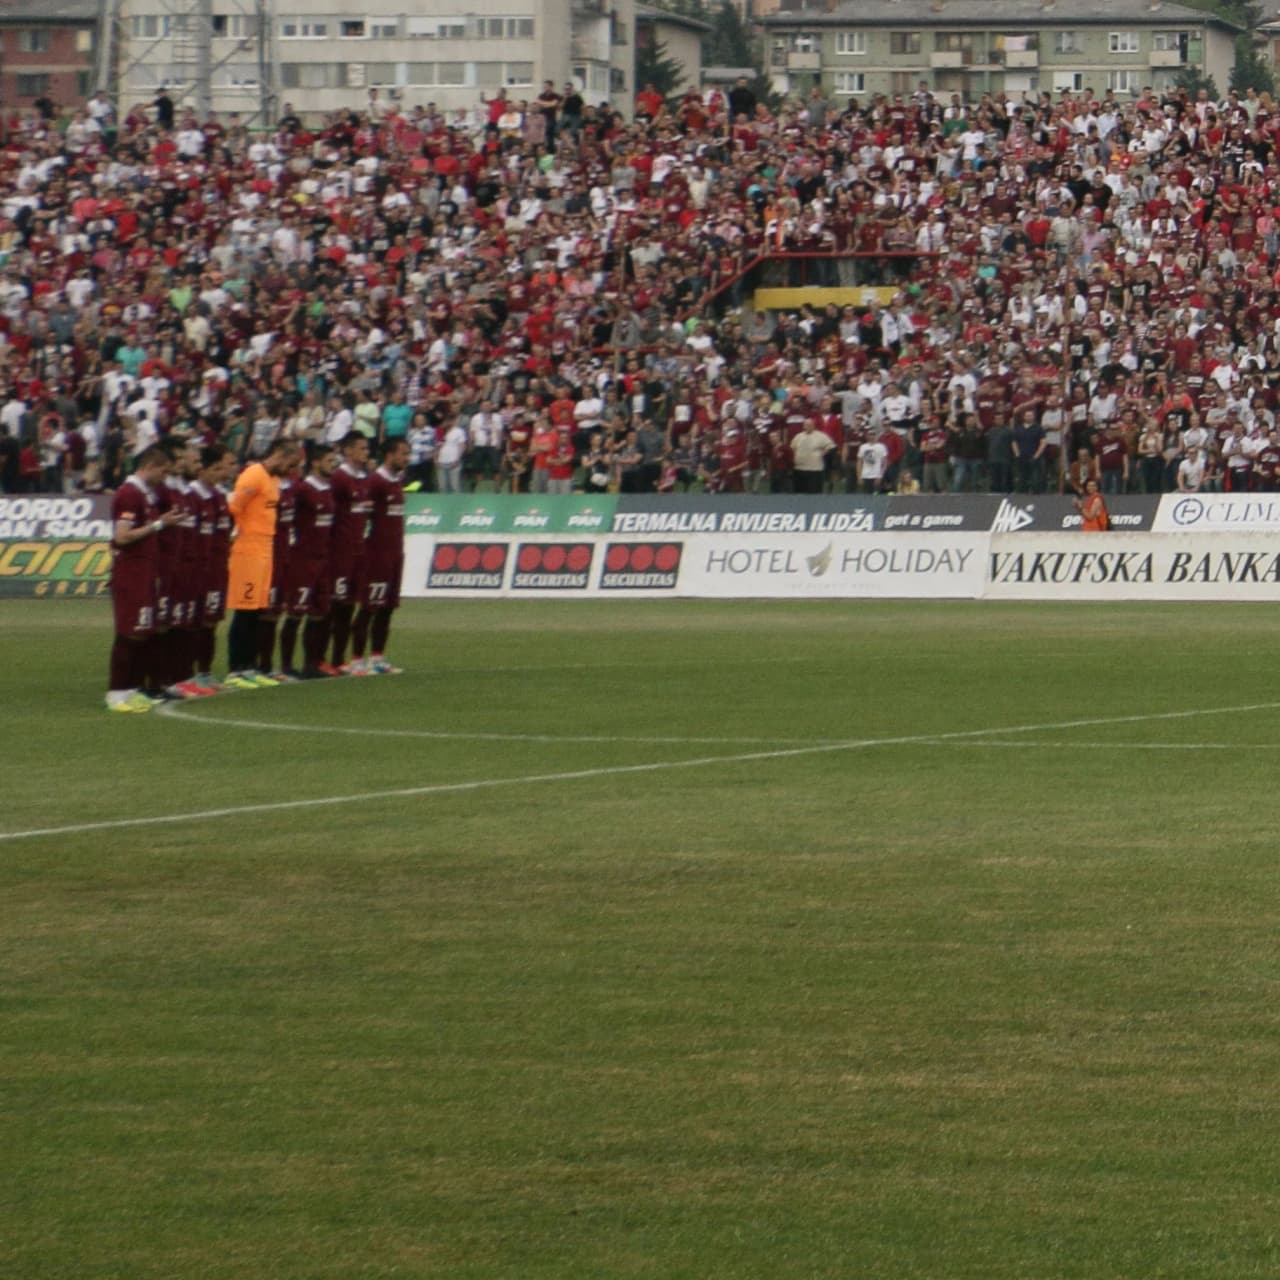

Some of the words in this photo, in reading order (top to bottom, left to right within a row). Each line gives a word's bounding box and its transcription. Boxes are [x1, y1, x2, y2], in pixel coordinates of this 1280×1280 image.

[612, 513, 715, 532] TERMALNA
[720, 513, 806, 532] RIVIJERA
[809, 509, 875, 532] ILIDŽA
[922, 515, 964, 528] game
[1110, 515, 1143, 525] ame
[705, 550, 798, 574] HOTEL
[841, 548, 974, 574] HOLIDAY
[989, 552, 1154, 584] VAKUFSKA
[429, 574, 501, 588] SECURITAS
[514, 574, 587, 588] SECURITAS
[603, 573, 675, 588] SECURITAS
